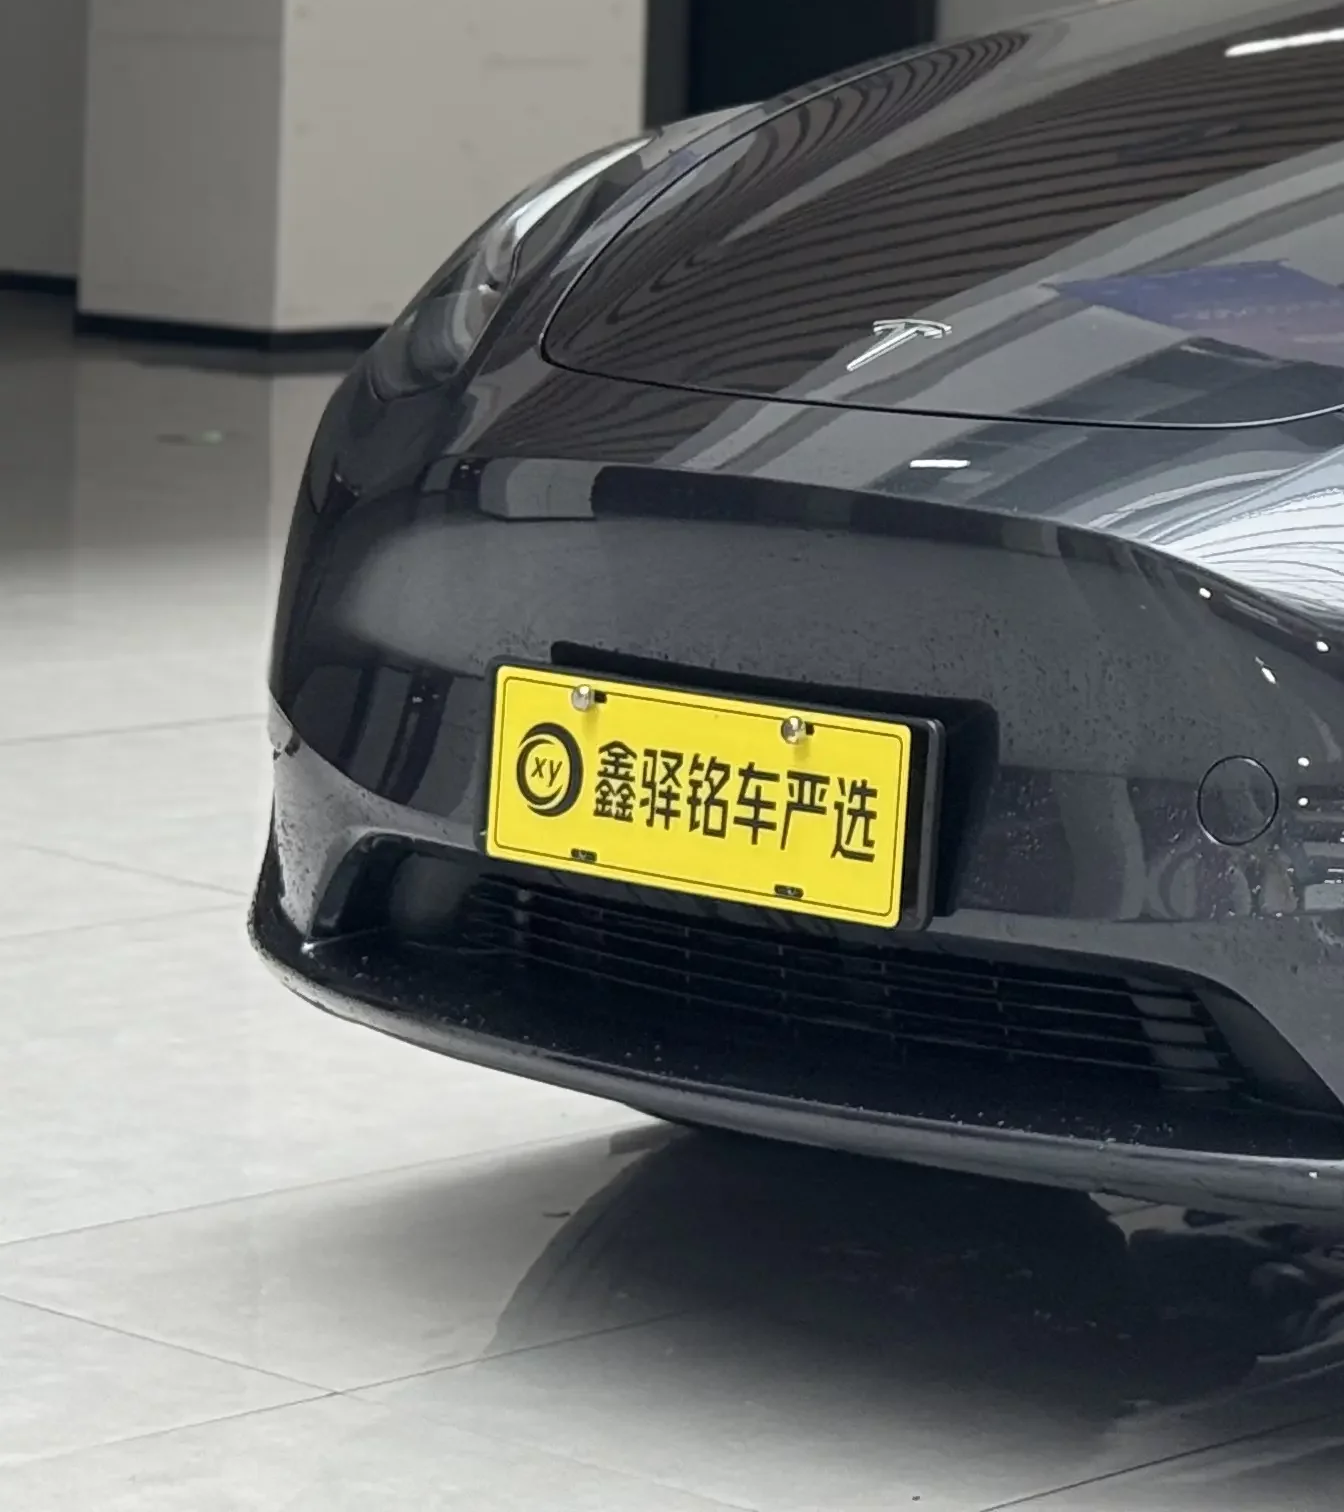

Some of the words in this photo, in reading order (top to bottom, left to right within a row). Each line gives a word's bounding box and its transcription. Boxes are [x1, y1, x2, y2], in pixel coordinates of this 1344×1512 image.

[593, 740, 880, 863] 鑫驿铭车严选
